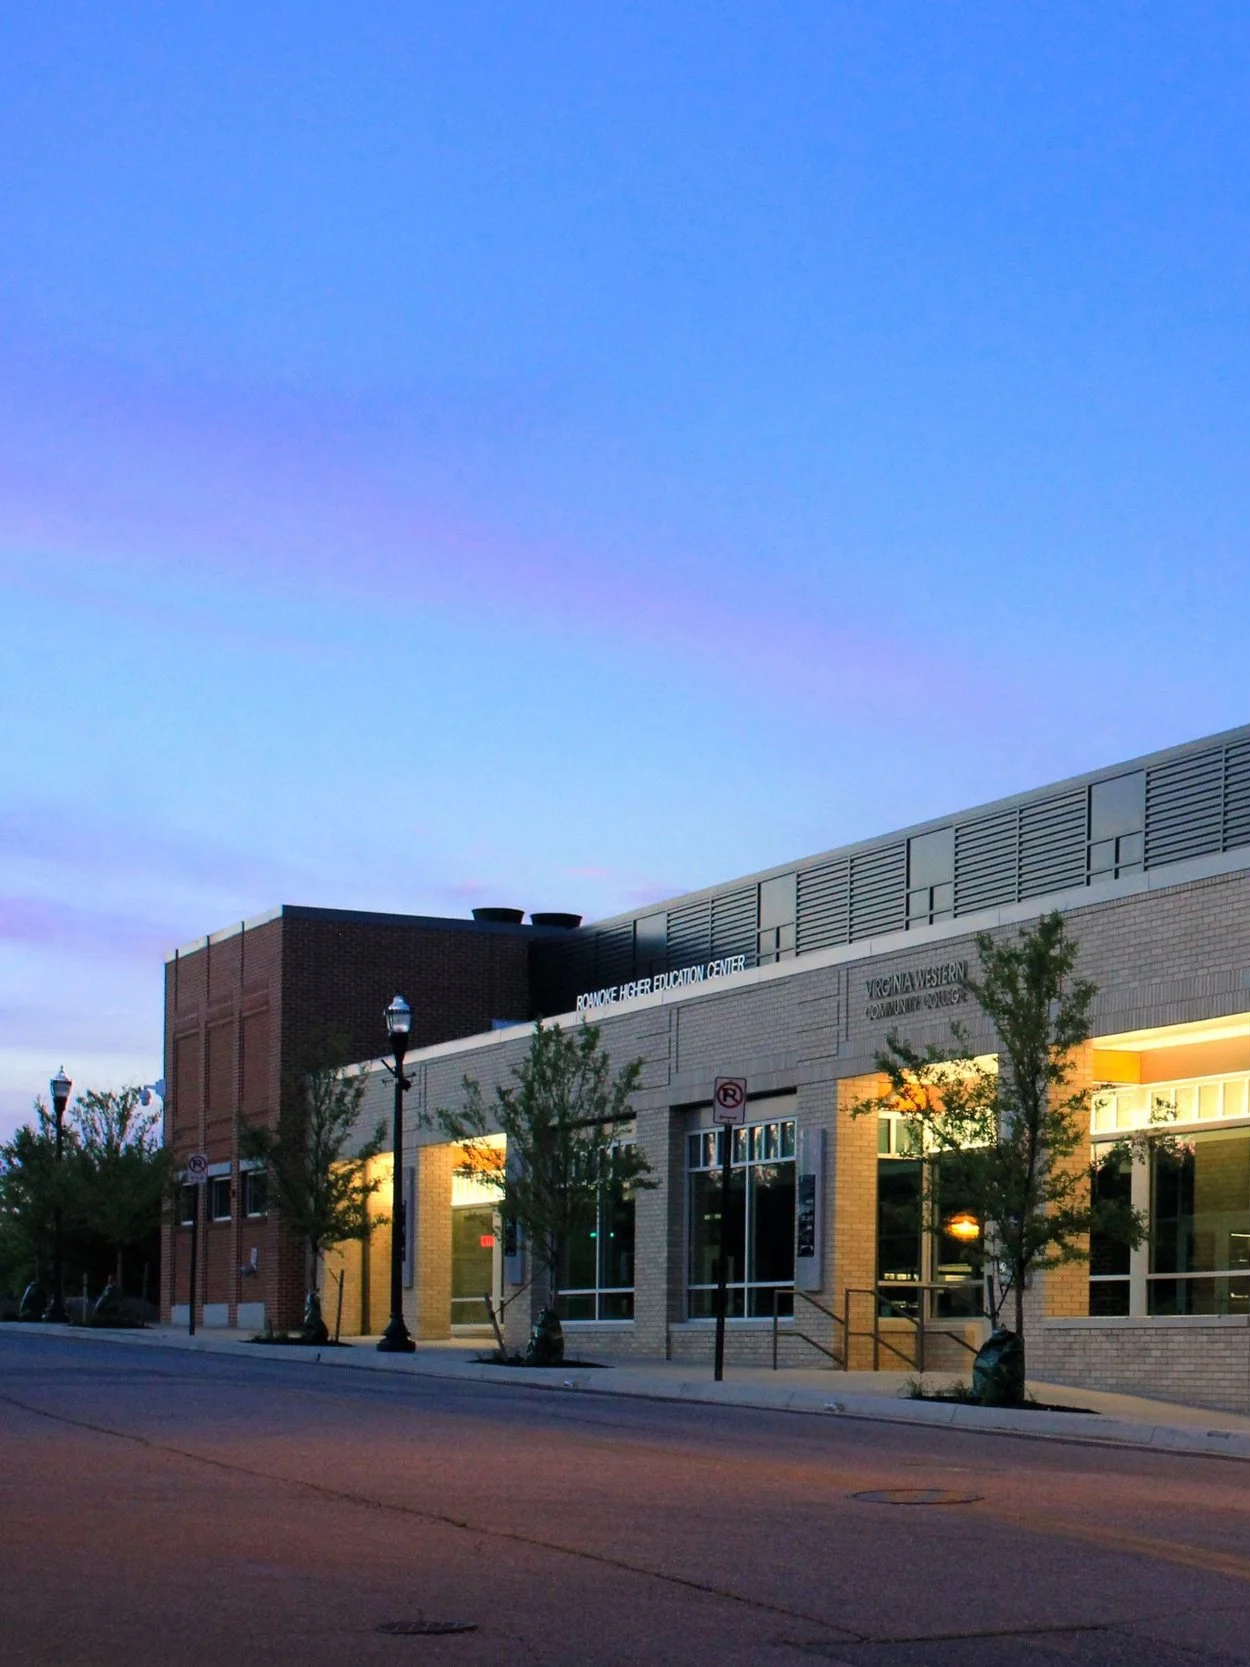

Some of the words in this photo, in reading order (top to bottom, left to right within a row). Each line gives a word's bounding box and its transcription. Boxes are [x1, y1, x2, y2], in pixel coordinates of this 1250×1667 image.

[576, 986, 619, 1011] ROANOKE
[619, 978, 651, 1000] HIGHER
[653, 965, 704, 993] EDUCATION
[708, 954, 745, 979] CENTER
[866, 972, 912, 999] VIRGINIA
[915, 961, 966, 989] WESTERN
